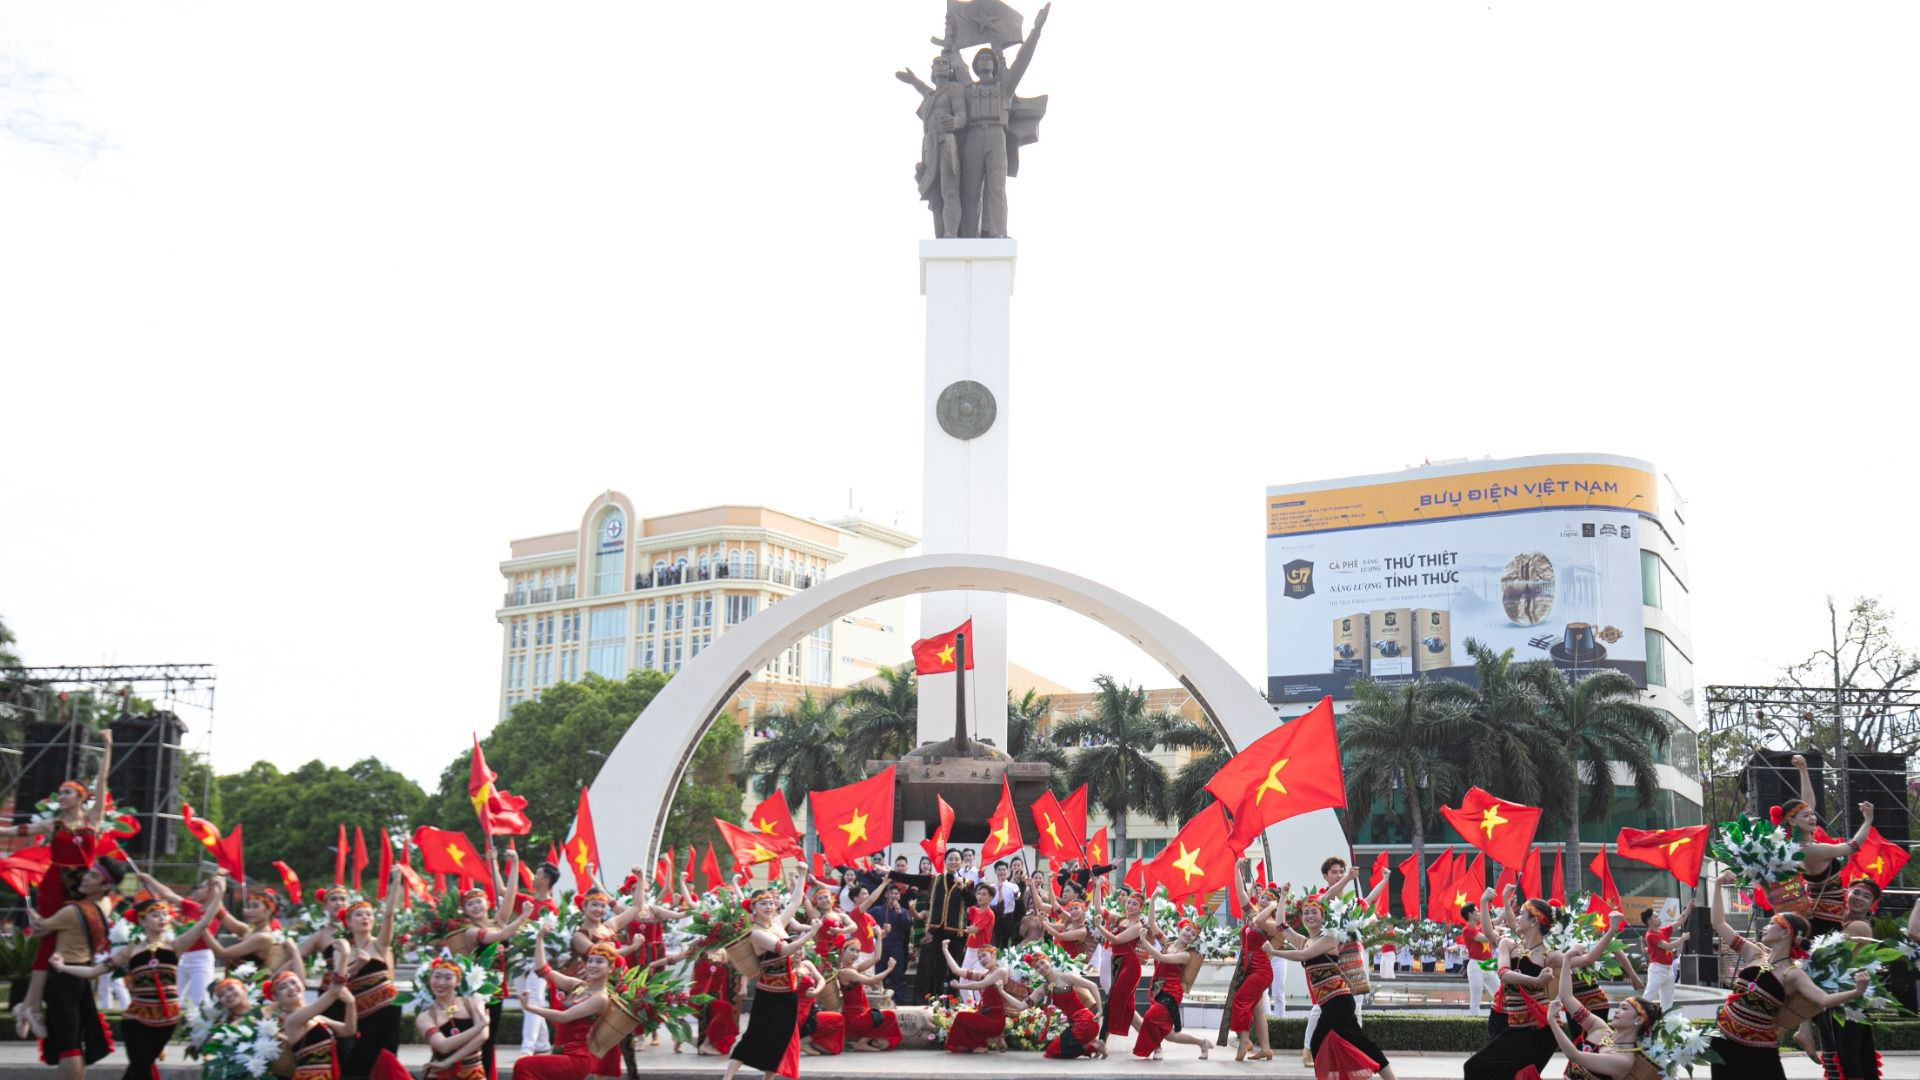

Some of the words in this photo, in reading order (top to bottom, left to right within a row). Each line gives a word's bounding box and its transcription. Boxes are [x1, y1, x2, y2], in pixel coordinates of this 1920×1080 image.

[1523, 478, 1570, 496] VIỆT
[1574, 480, 1618, 493] NAM
[1384, 553, 1415, 570] THỨ
[1418, 549, 1458, 568] THIỆT
[1286, 566, 1312, 585] G7
[1421, 569, 1459, 585] THỨC
